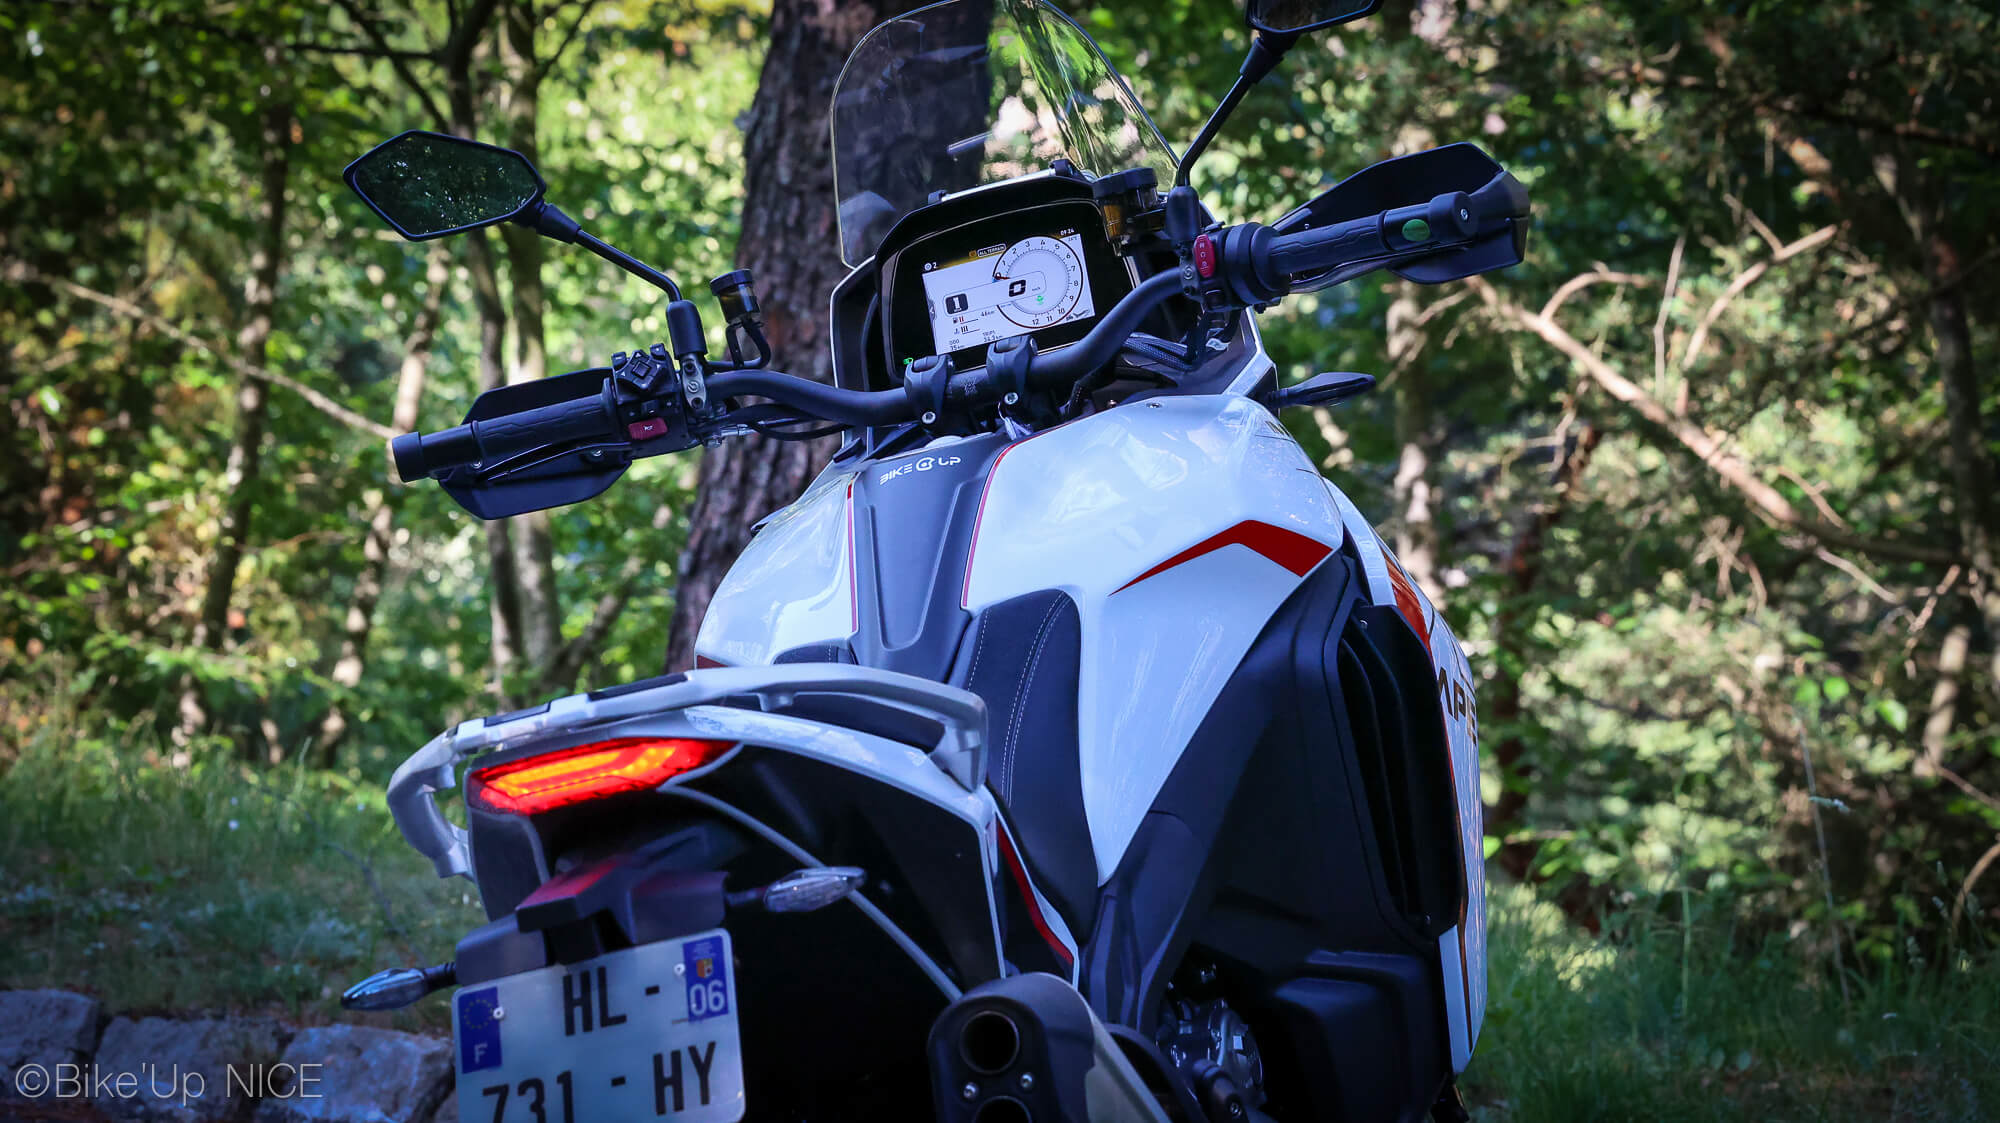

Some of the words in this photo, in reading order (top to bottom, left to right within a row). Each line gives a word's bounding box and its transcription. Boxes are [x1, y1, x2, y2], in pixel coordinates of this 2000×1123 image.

[987, 245, 1005, 254] TERRAIN
[1008, 280, 1026, 297] 0
[952, 296, 962, 312] 1
[880, 463, 913, 485] BIKE
[562, 966, 627, 1036] HL
[690, 979, 725, 1016] 06
[474, 1043, 488, 1064] F
[482, 1070, 574, 1123] 731
[653, 1041, 716, 1116] HY
